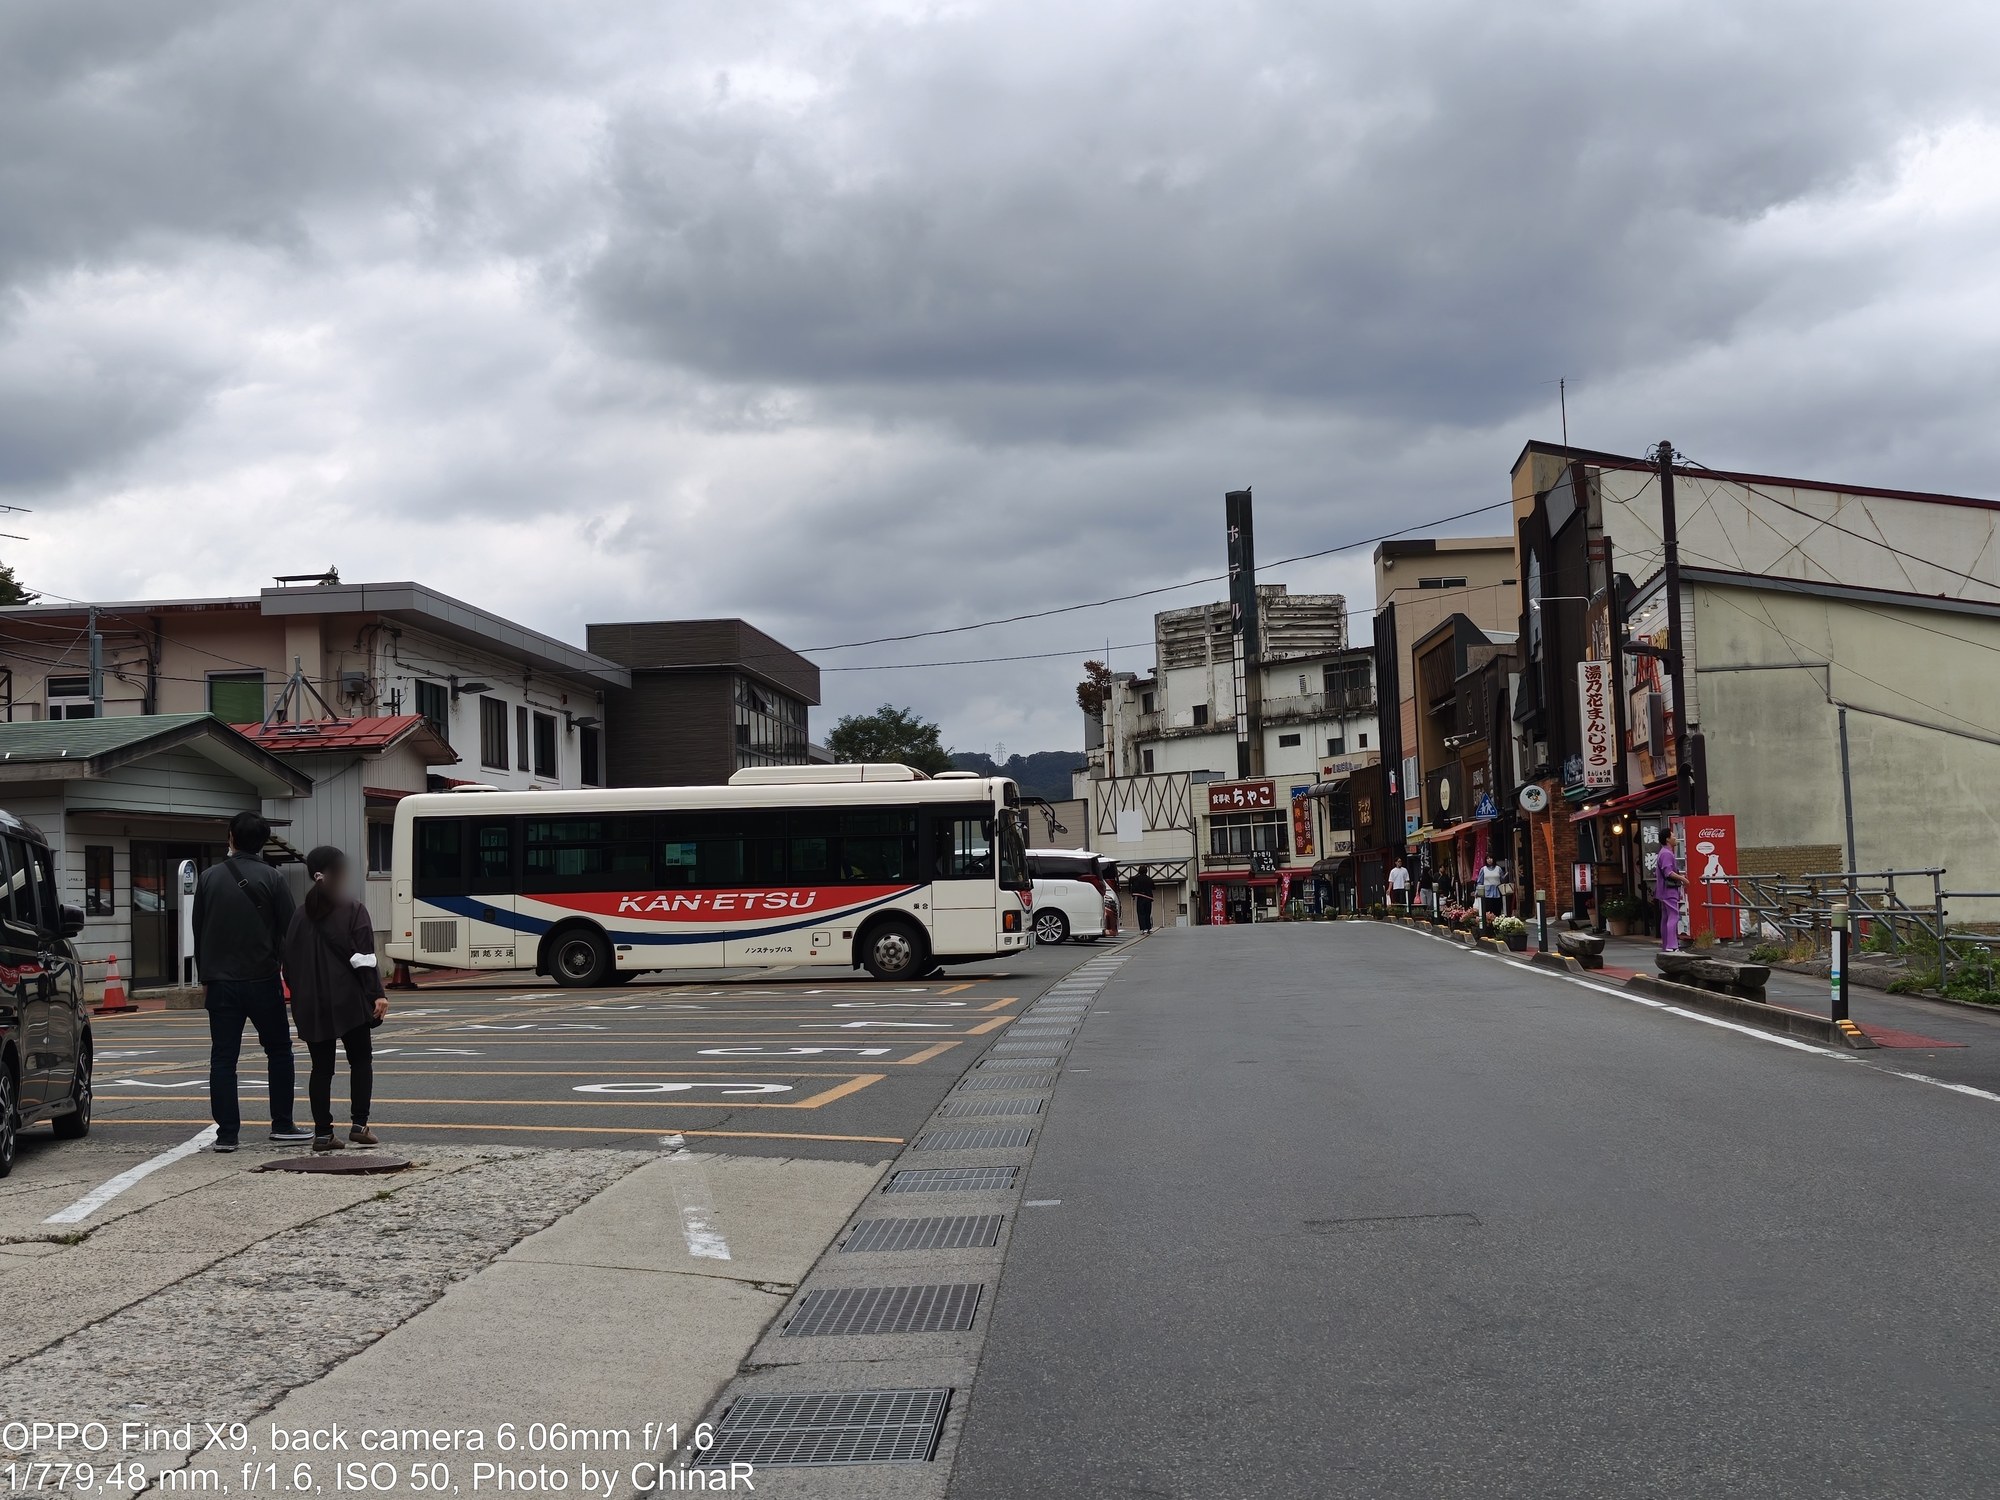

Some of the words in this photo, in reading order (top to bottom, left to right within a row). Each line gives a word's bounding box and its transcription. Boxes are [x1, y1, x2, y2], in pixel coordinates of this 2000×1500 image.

[1227, 525, 1242, 620] ホテル
[1585, 665, 1607, 766] 湯乃花まんじゅう
[1233, 786, 1271, 807] ちゃこ
[1643, 826, 1660, 871] 漬物
[1213, 887, 1224, 925] 営業中
[745, 946, 793, 954] ノンステップバス
[572, 1082, 793, 1095] 6
